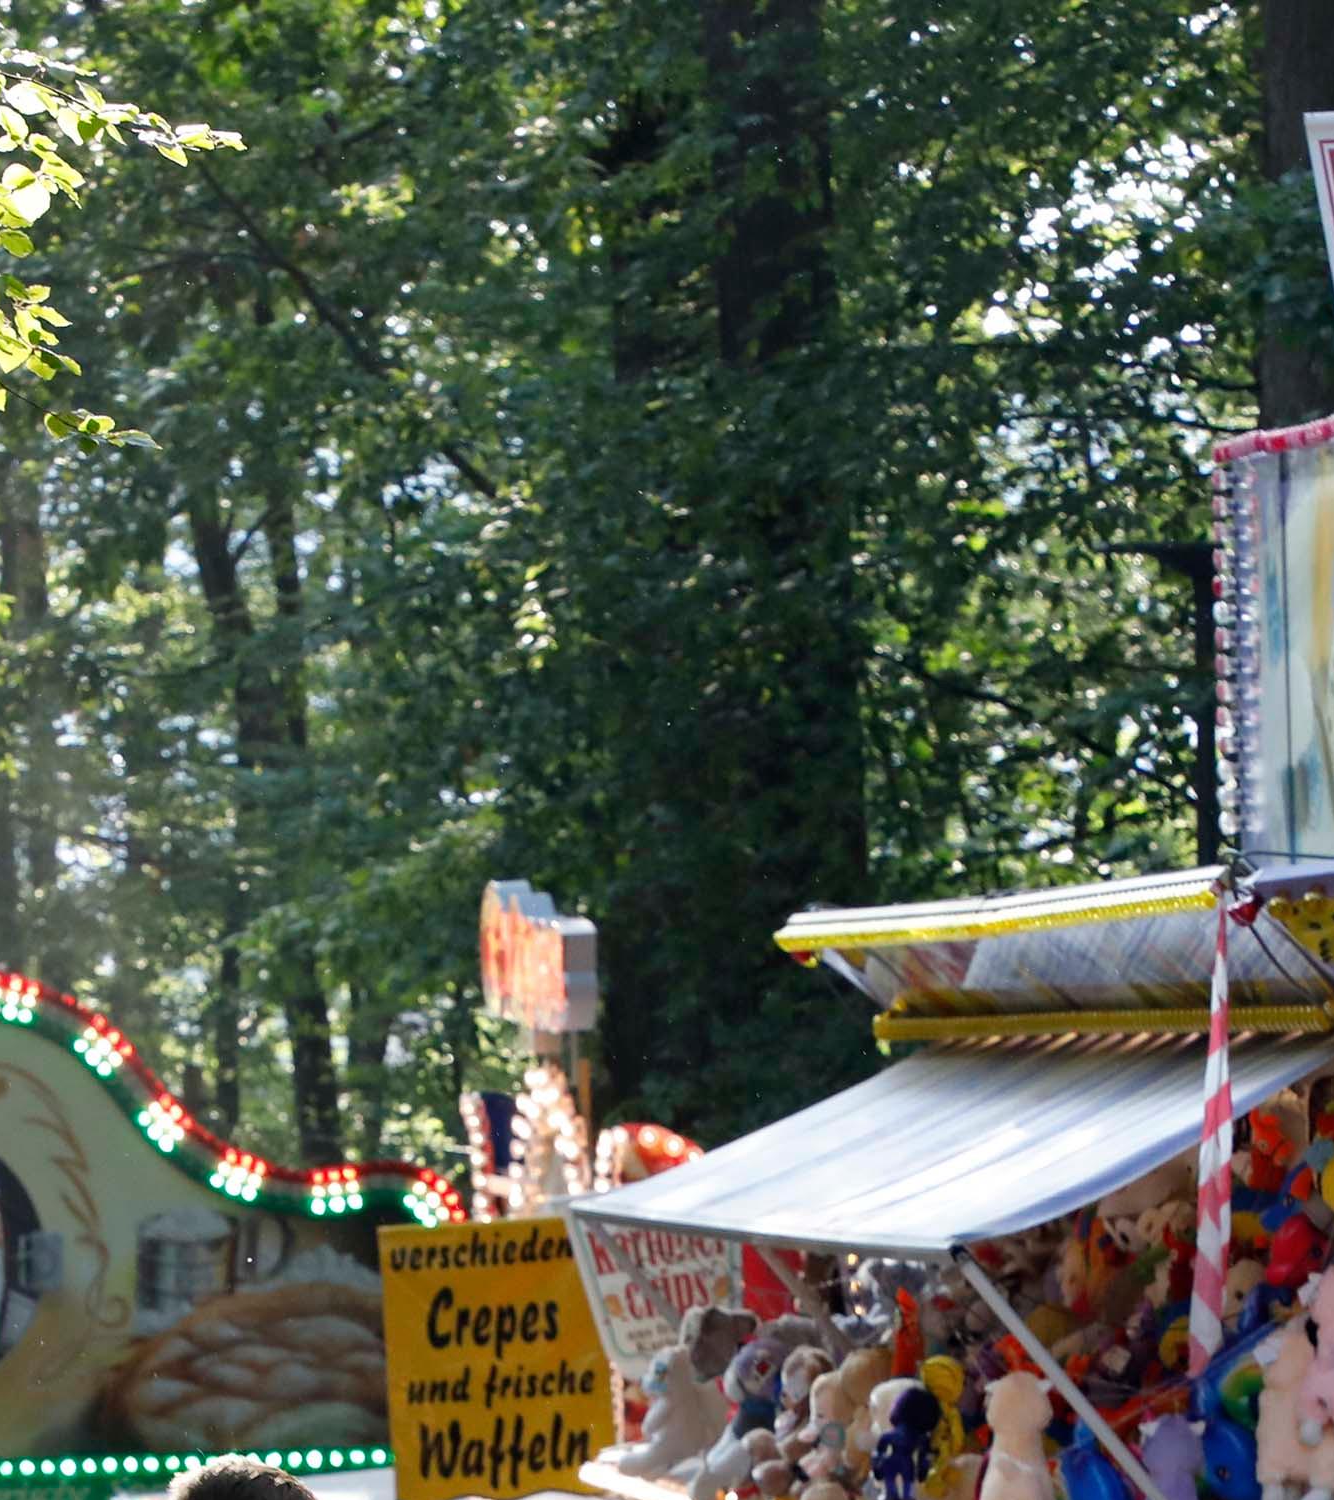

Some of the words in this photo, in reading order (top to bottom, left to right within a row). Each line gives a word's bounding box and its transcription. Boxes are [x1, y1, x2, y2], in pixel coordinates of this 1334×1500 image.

[390, 1227, 574, 1272] verschieden
[426, 1285, 560, 1359] Crepes
[407, 1366, 471, 1405] und
[484, 1359, 596, 1409] frische
[419, 1413, 591, 1491] Waffeln
